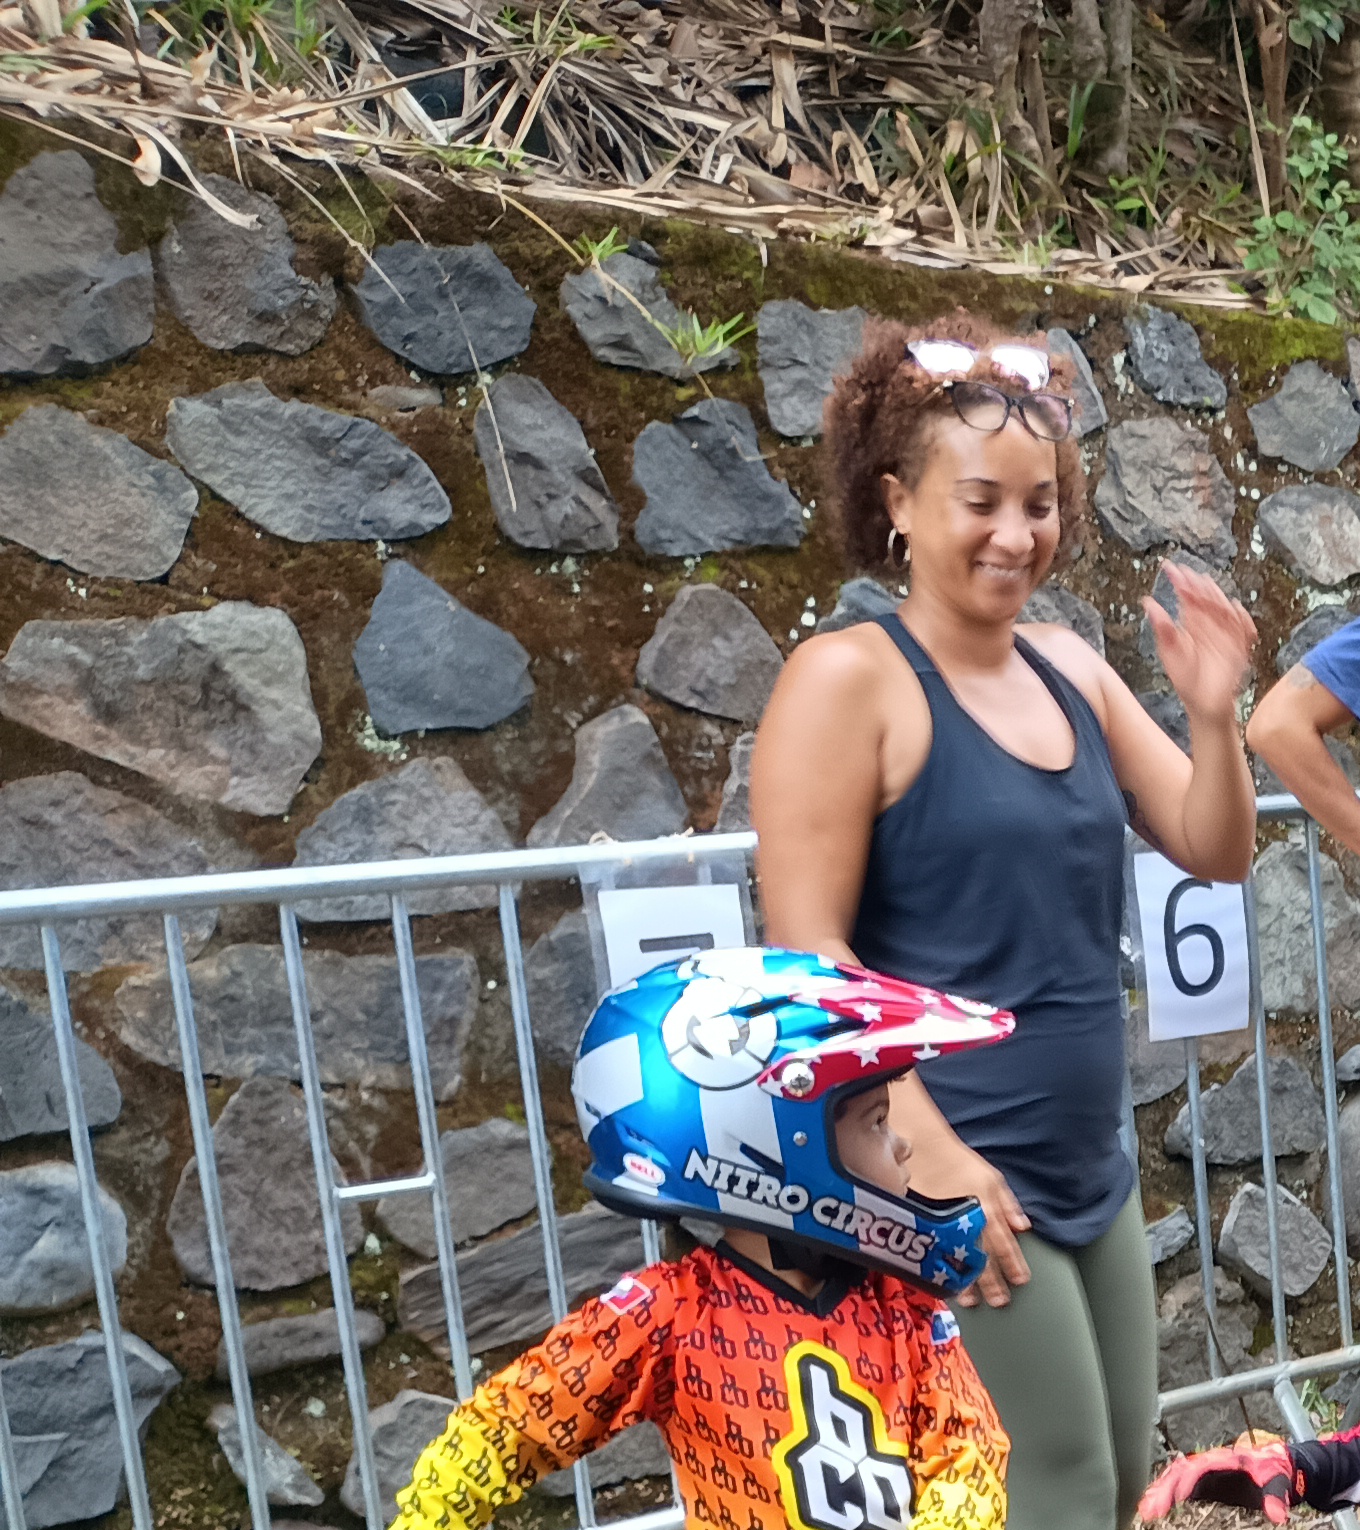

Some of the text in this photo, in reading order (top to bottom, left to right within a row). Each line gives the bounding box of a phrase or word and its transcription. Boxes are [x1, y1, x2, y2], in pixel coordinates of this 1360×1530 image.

[1163, 877, 1225, 997] 6
[683, 1148, 935, 1263] NITRO CIRCUS
